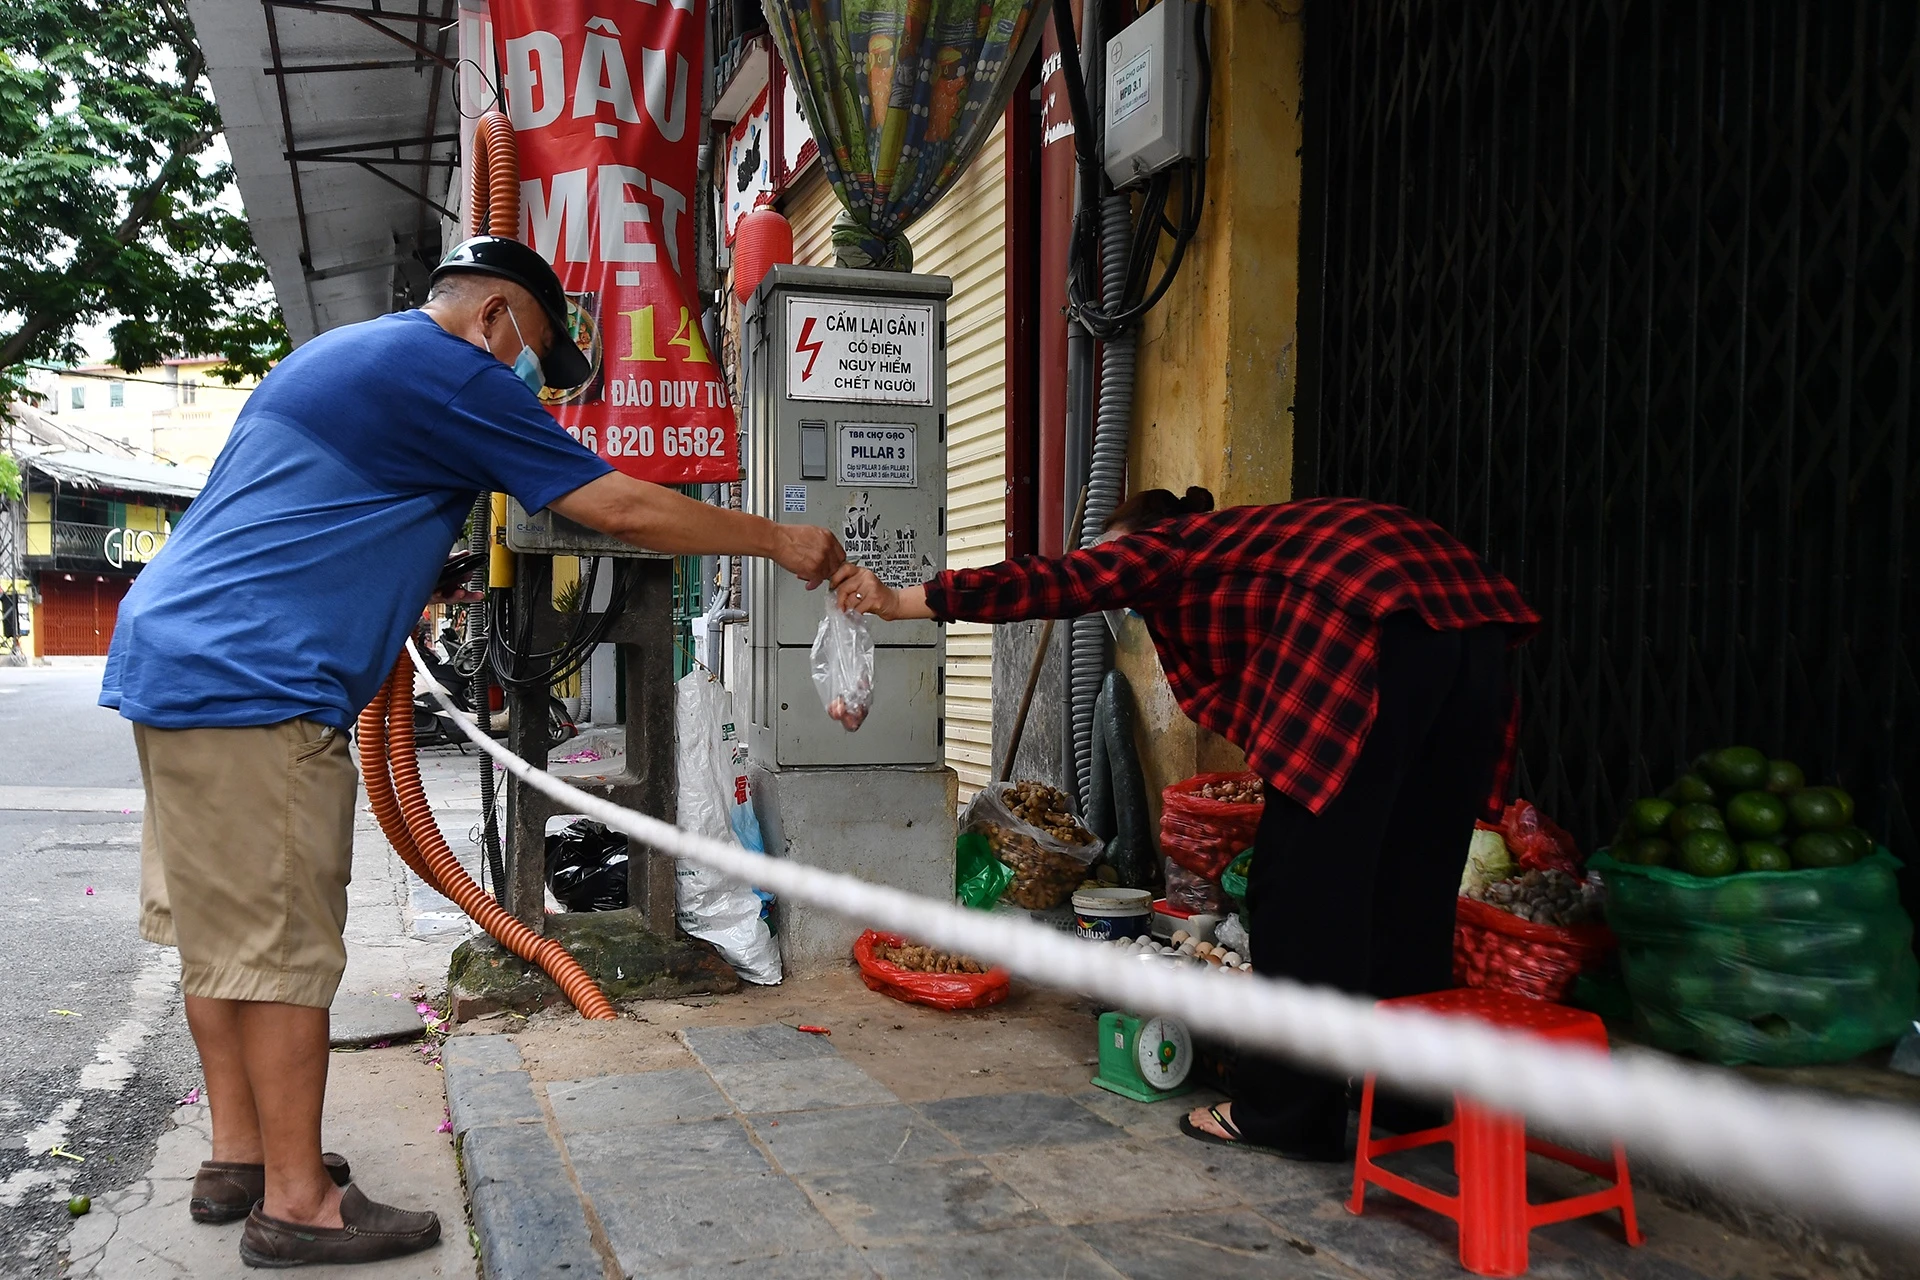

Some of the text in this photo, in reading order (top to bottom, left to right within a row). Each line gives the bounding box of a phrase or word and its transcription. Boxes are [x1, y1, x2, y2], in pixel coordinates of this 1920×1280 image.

[504, 16, 689, 143] ĐẬU
[518, 164, 687, 287] MẸT
[618, 304, 712, 364] 14
[826, 310, 857, 332] CẤM
[861, 317, 883, 338] LẠI
[887, 313, 917, 336] GẦN
[848, 339, 902, 358] CÓ ĐIỆN
[839, 357, 911, 374] NGUY HIỂM
[611, 373, 653, 407] ĐÀO
[659, 380, 699, 408] DUY
[834, 375, 916, 392] CHẾT NGƯỜI
[606, 425, 654, 457] 820
[663, 426, 725, 457] 6582
[849, 431, 864, 439] TBA
[851, 445, 905, 459] PILLAR 3
[1077, 925, 1106, 940] Dulux
